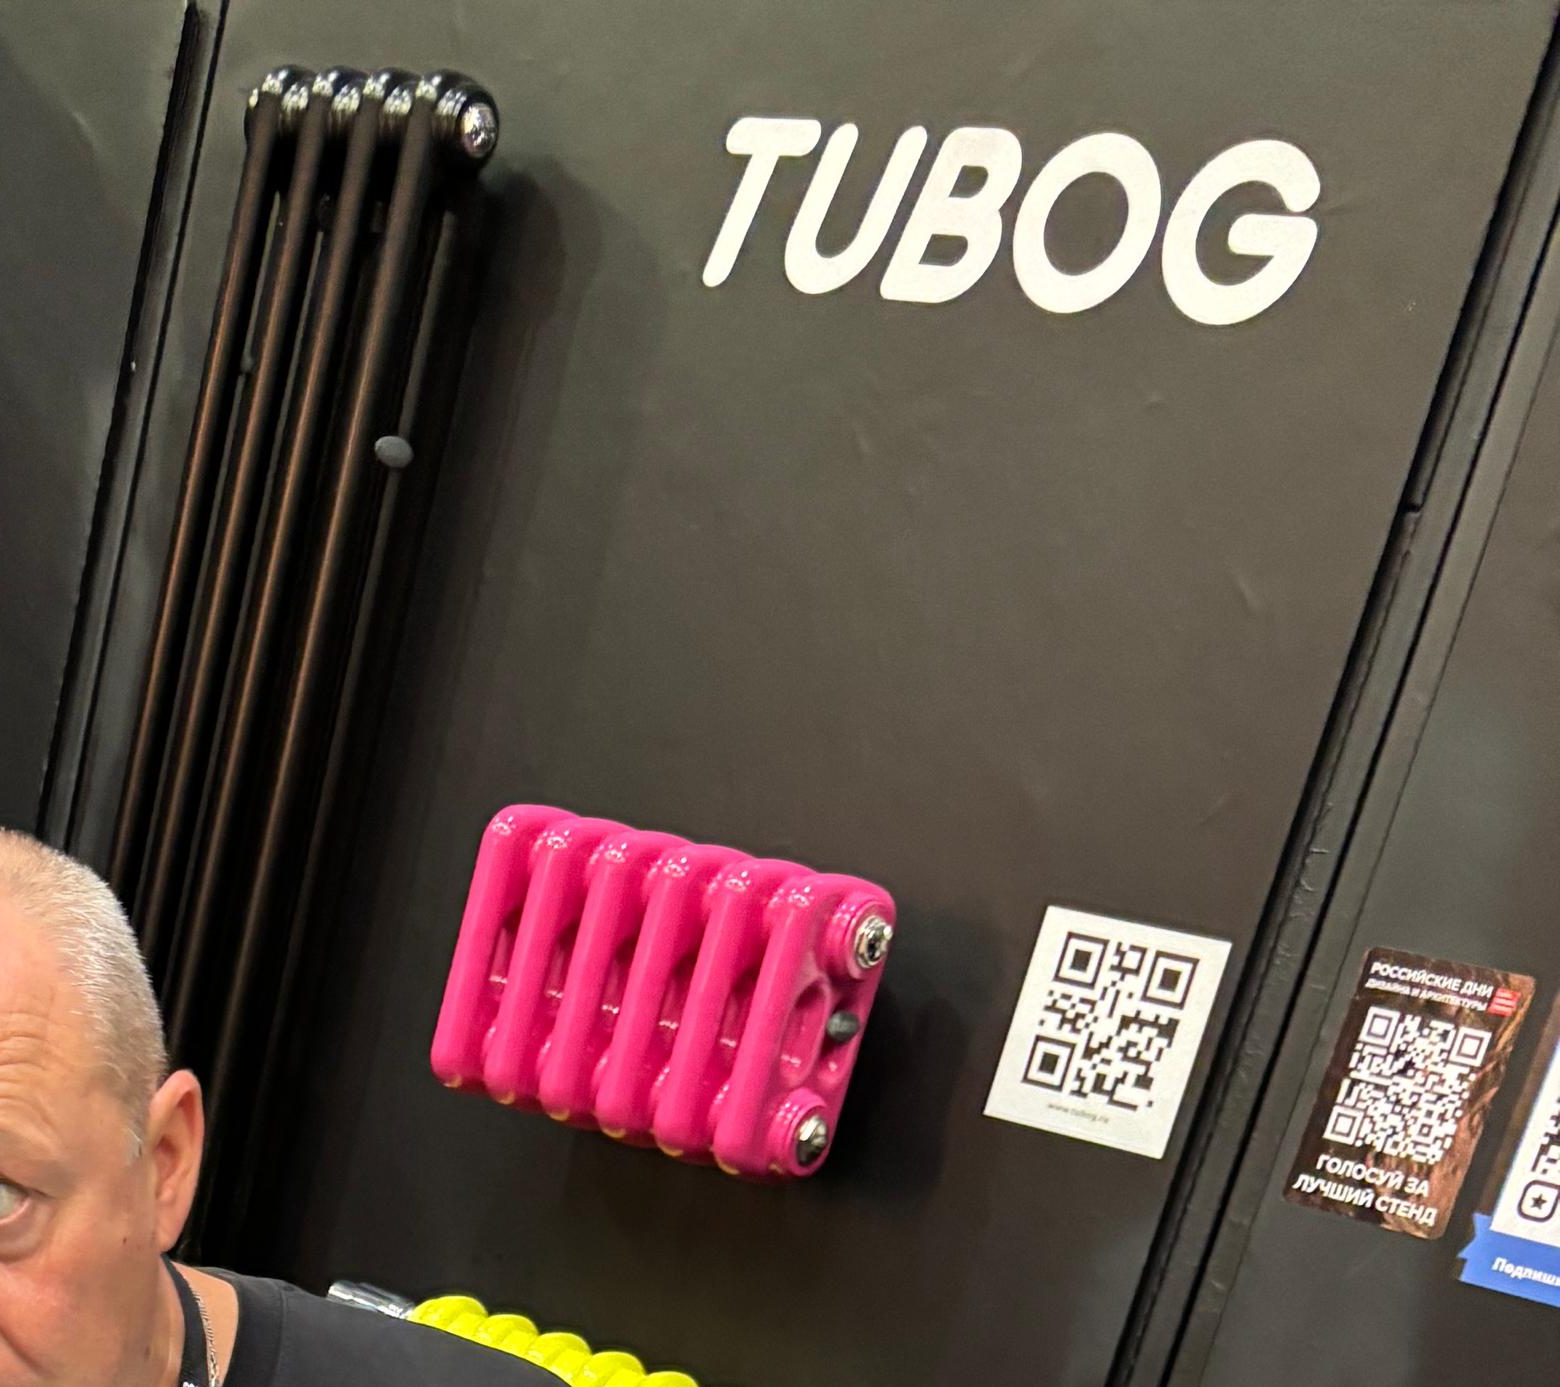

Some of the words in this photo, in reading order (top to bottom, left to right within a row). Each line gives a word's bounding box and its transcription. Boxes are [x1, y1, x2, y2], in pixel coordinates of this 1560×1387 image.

[701, 116, 1322, 327] TUBOG
[1370, 961, 1462, 992] РОССИЙСКИЕ
[1462, 981, 1494, 998] ДНИ
[1315, 1154, 1404, 1191] ГОЛОСУЙ
[1404, 1178, 1430, 1197] ЗА
[1292, 1173, 1376, 1208] ЛУЧШИЙ
[1375, 1195, 1438, 1227] СТЕНД
